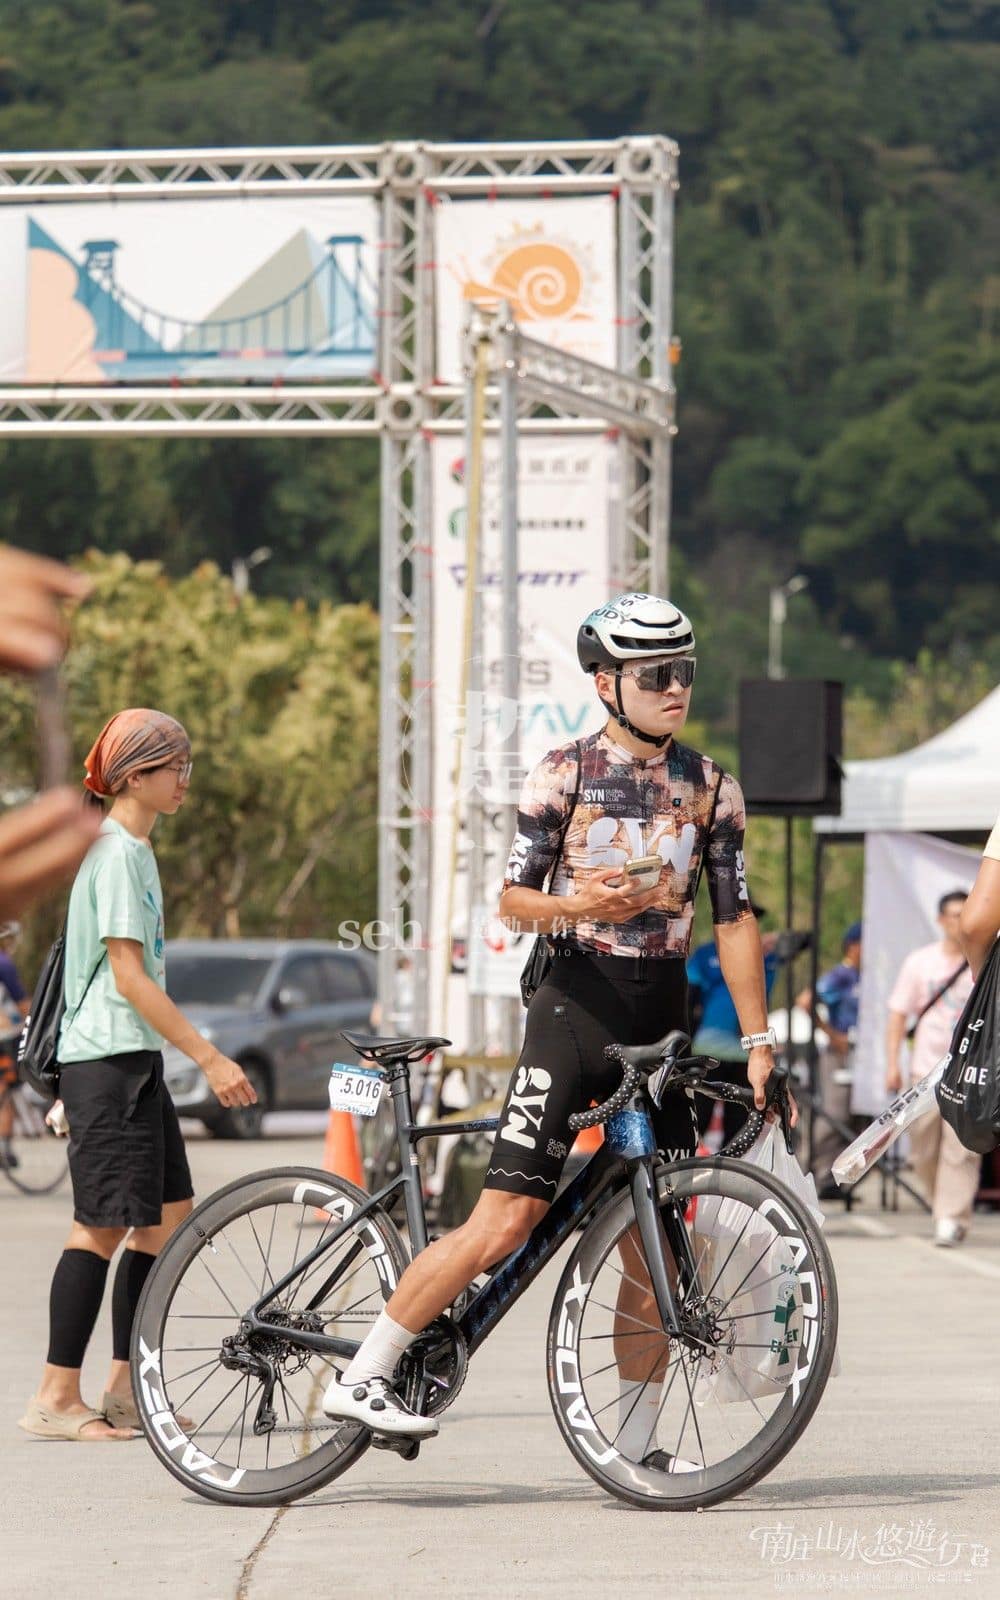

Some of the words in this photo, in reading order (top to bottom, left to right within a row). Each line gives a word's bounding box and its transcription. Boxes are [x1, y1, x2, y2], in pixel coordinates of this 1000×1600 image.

[584, 788, 605, 802] SYN
[500, 1066, 552, 1149] SYN
[556, 1262, 620, 1466] CADEX
[761, 1198, 820, 1407] CADEX
[139, 1336, 247, 1489] CADEX
